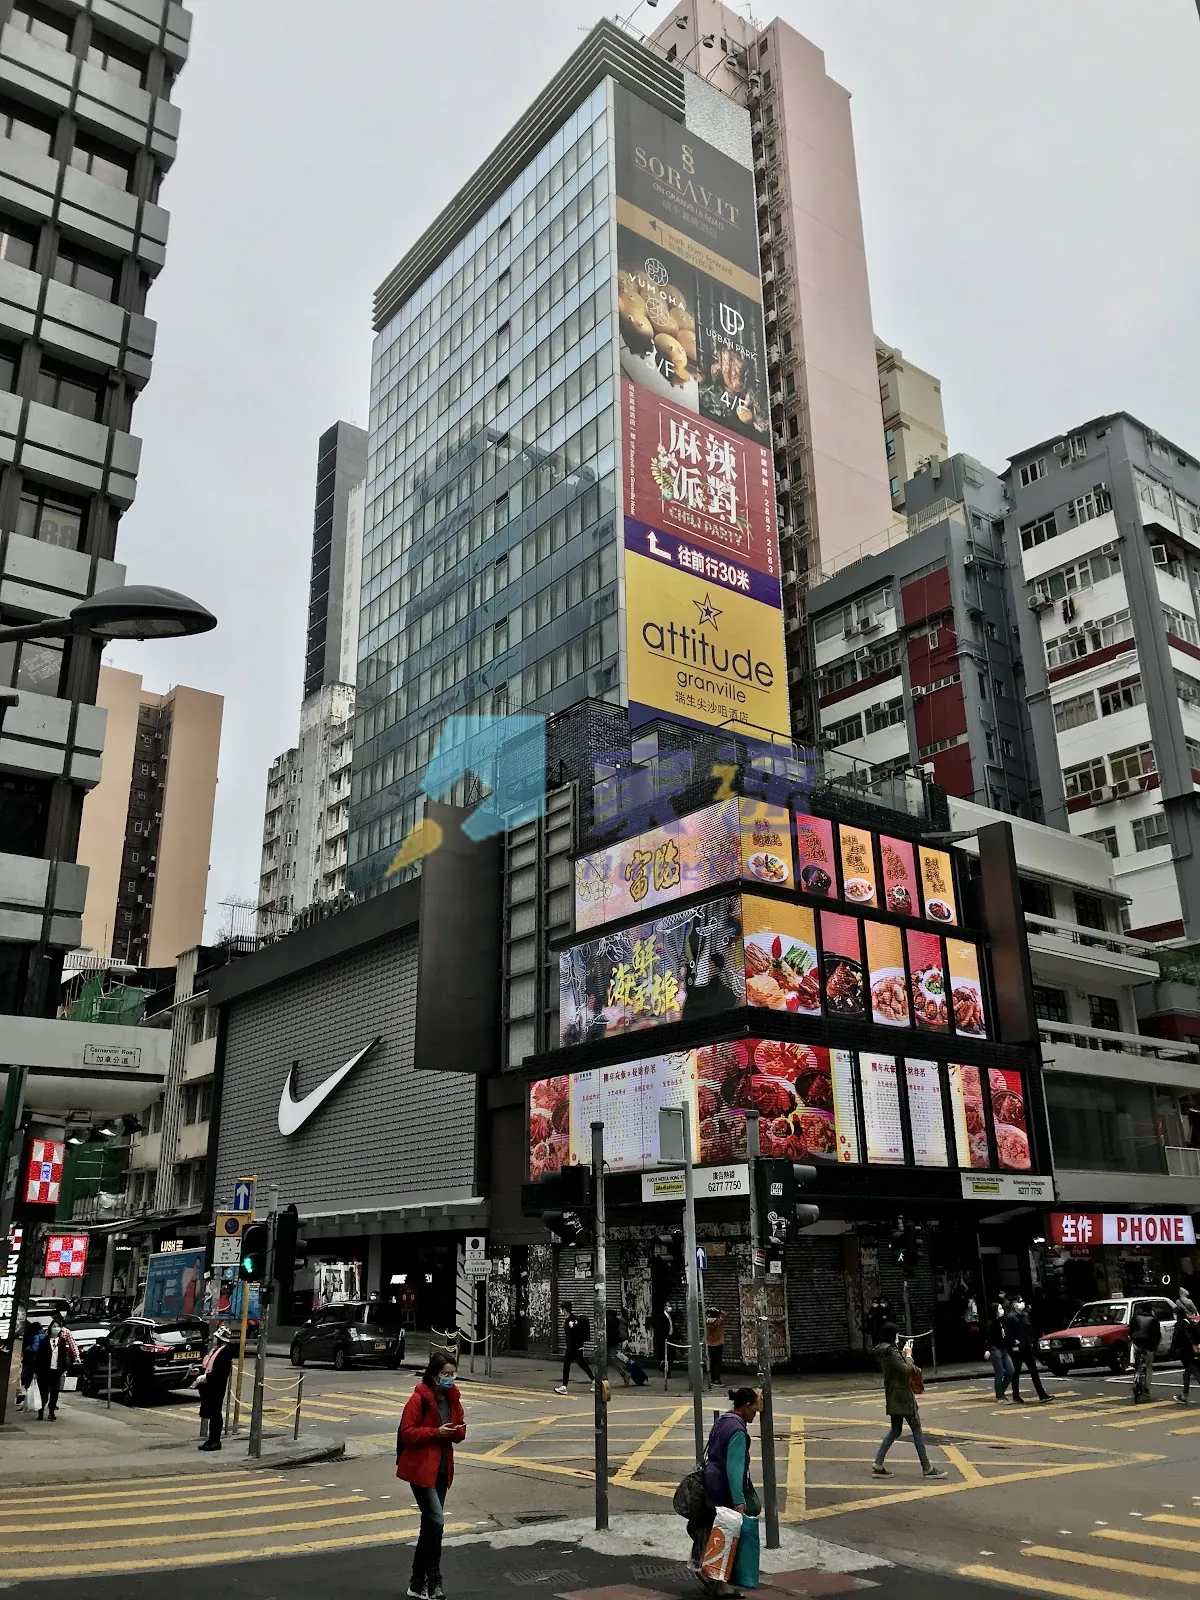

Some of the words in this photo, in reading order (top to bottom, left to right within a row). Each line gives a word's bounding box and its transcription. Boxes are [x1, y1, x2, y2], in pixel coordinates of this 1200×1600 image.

[635, 147, 739, 224] SORAVIT
[628, 272, 687, 311] YUMOHA
[706, 327, 734, 350] URBAN
[735, 342, 756, 360] PARK
[720, 390, 749, 414] 4/F
[677, 544, 750, 590] 往前行30米
[642, 621, 774, 687] attitude
[677, 671, 747, 703] granville
[675, 691, 749, 723] 瑞生尖沙咀酒店
[708, 1182, 724, 1192] 6277
[725, 1180, 742, 1190] 7750
[1062, 1215, 1093, 1243] 生作
[1117, 1217, 1185, 1242] PHONE
[160, 1241, 176, 1252] LUSH
